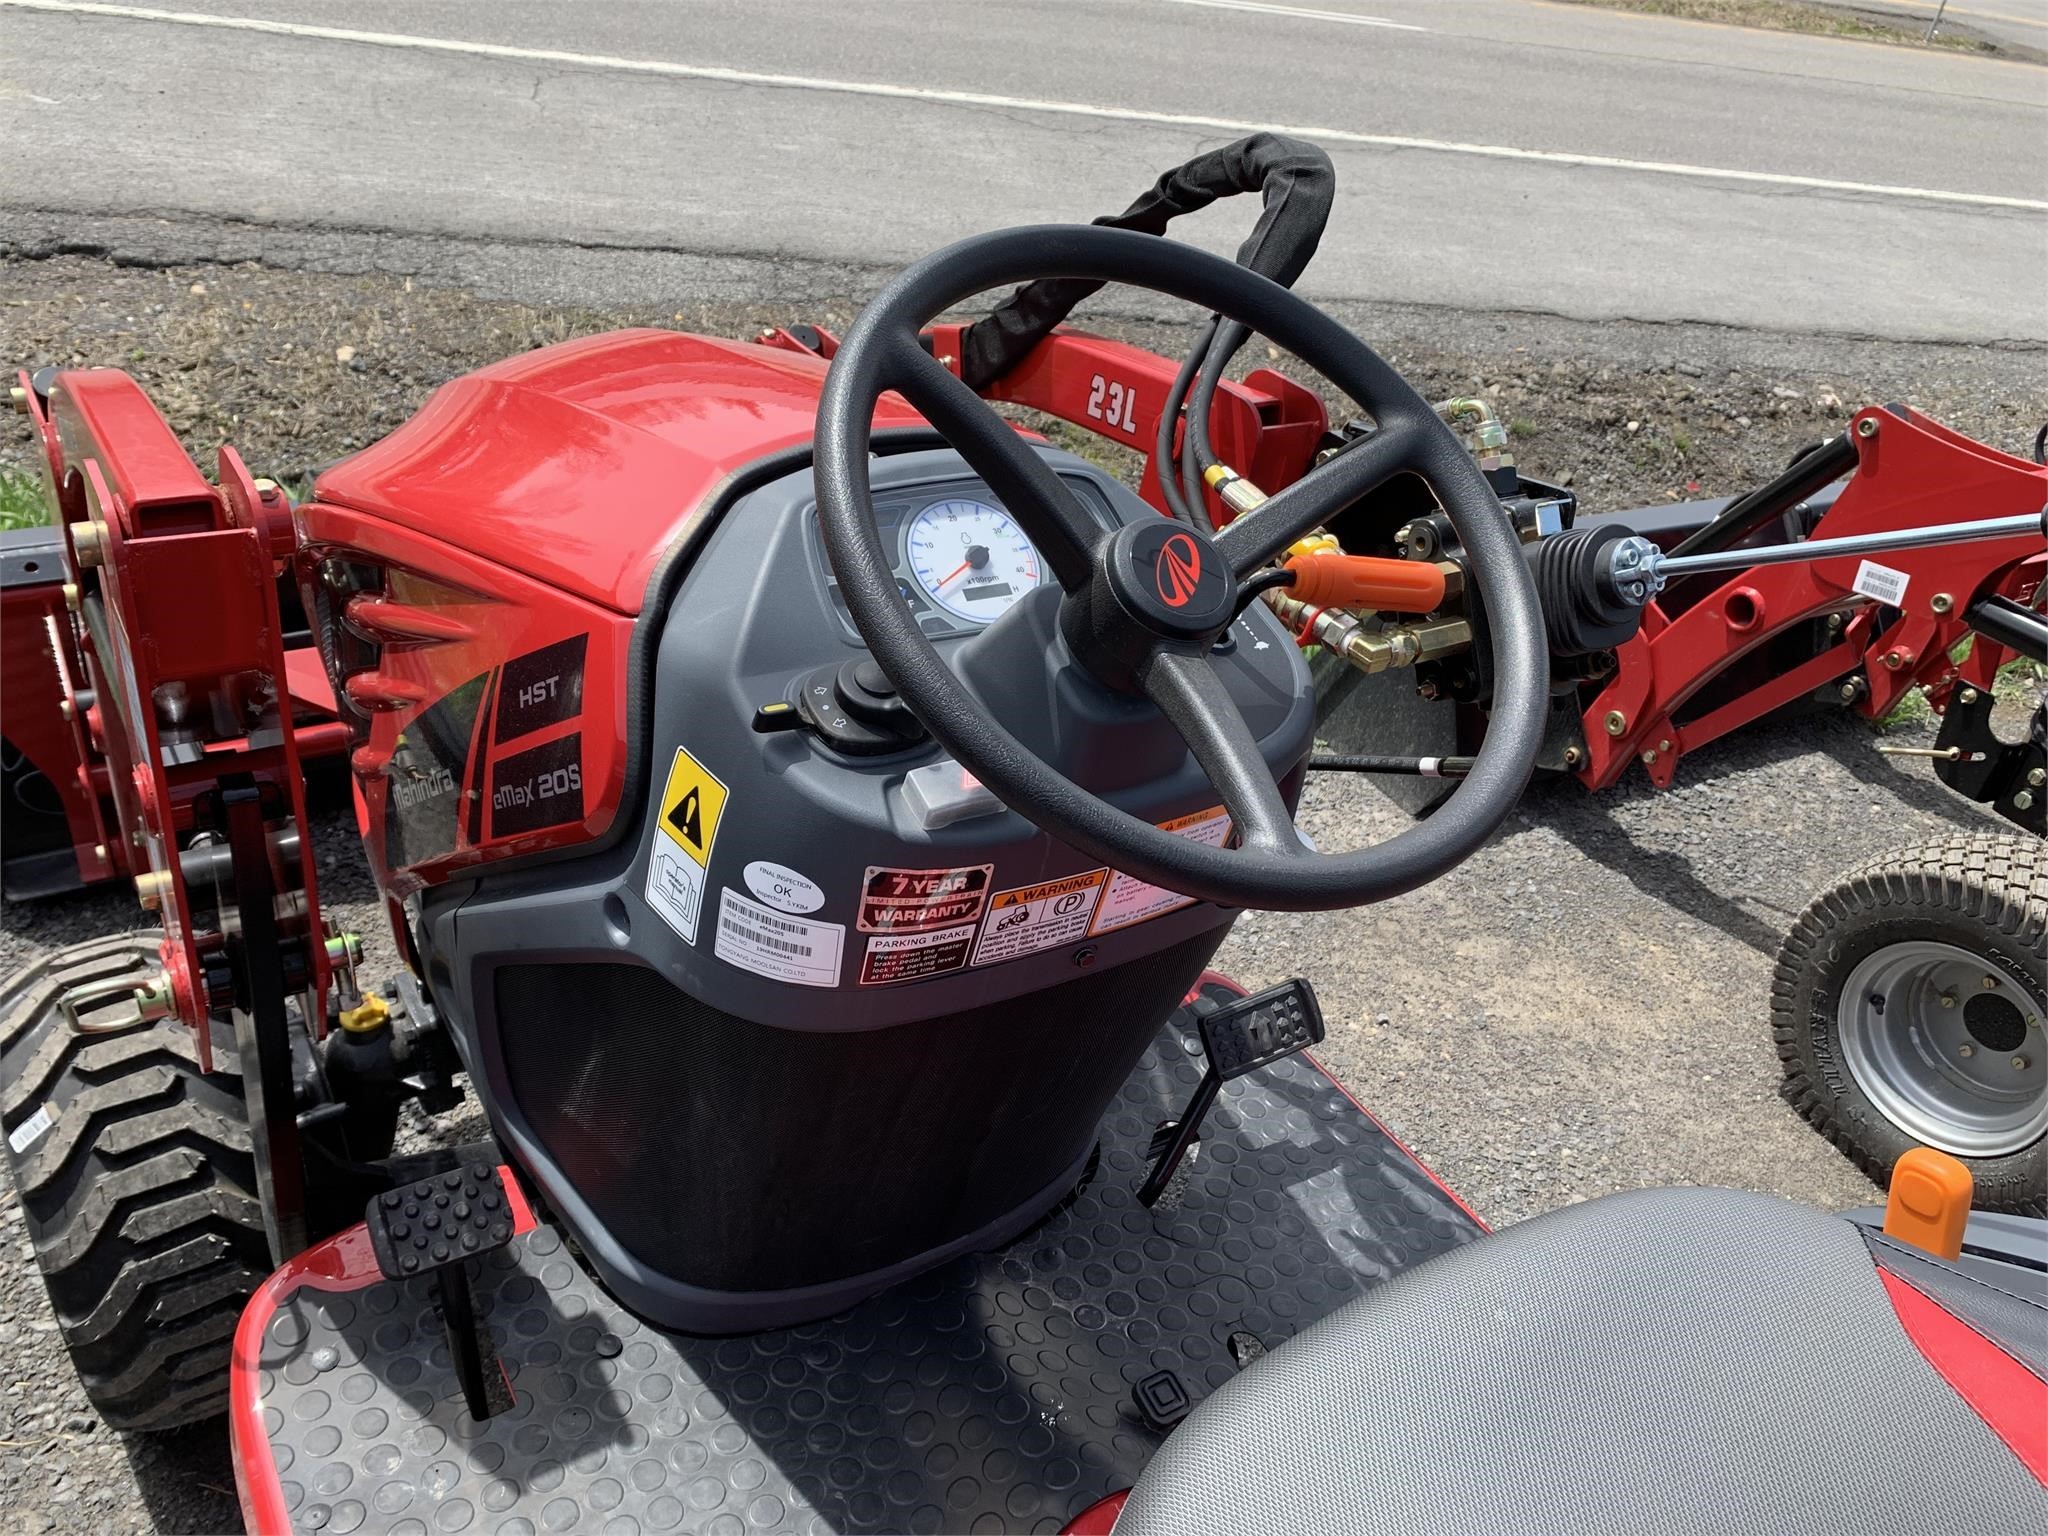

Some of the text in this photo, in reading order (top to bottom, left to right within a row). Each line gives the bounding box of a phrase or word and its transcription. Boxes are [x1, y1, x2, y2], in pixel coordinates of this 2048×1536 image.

[1087, 373, 1137, 434] 23L
[992, 527, 1002, 535] 30
[967, 575, 1000, 585] x100rpm
[908, 599, 915, 608] F
[519, 675, 560, 709] HST
[392, 768, 454, 811] Mahindra
[493, 763, 582, 808] eMax 20S
[760, 866, 812, 890] FINAL INSPECTION
[893, 877, 967, 895] 7 YEAR
[756, 888, 781, 902] Inspector
[773, 884, 792, 898] OK
[1023, 876, 1094, 901] WARNING
[865, 890, 983, 905] LIMITED POWERTRAIN
[874, 901, 972, 922] WARRANTY
[738, 915, 752, 926] CODE
[721, 930, 737, 942] SERIAL
[874, 928, 969, 949] PARKING BRAKE
[981, 918, 1086, 949] position and apply the parking brake
[983, 933, 1003, 942] Always
[1004, 929, 1020, 938] place
[1021, 926, 1031, 934] the
[1031, 919, 1063, 931] transmission
[1018, 937, 1035, 947] Failure
[718, 943, 749, 962] TONGYANG
[750, 956, 782, 972] MOOLSAN
[900, 951, 921, 959] down
[938, 942, 963, 952] master
[978, 951, 1004, 961] accidents
[1005, 947, 1017, 956] and
[899, 956, 922, 965] pedal
[923, 953, 938, 961] and
[906, 959, 935, 971] parking
[938, 955, 957, 964] lever
[897, 969, 918, 977] same
[920, 965, 936, 973] time
